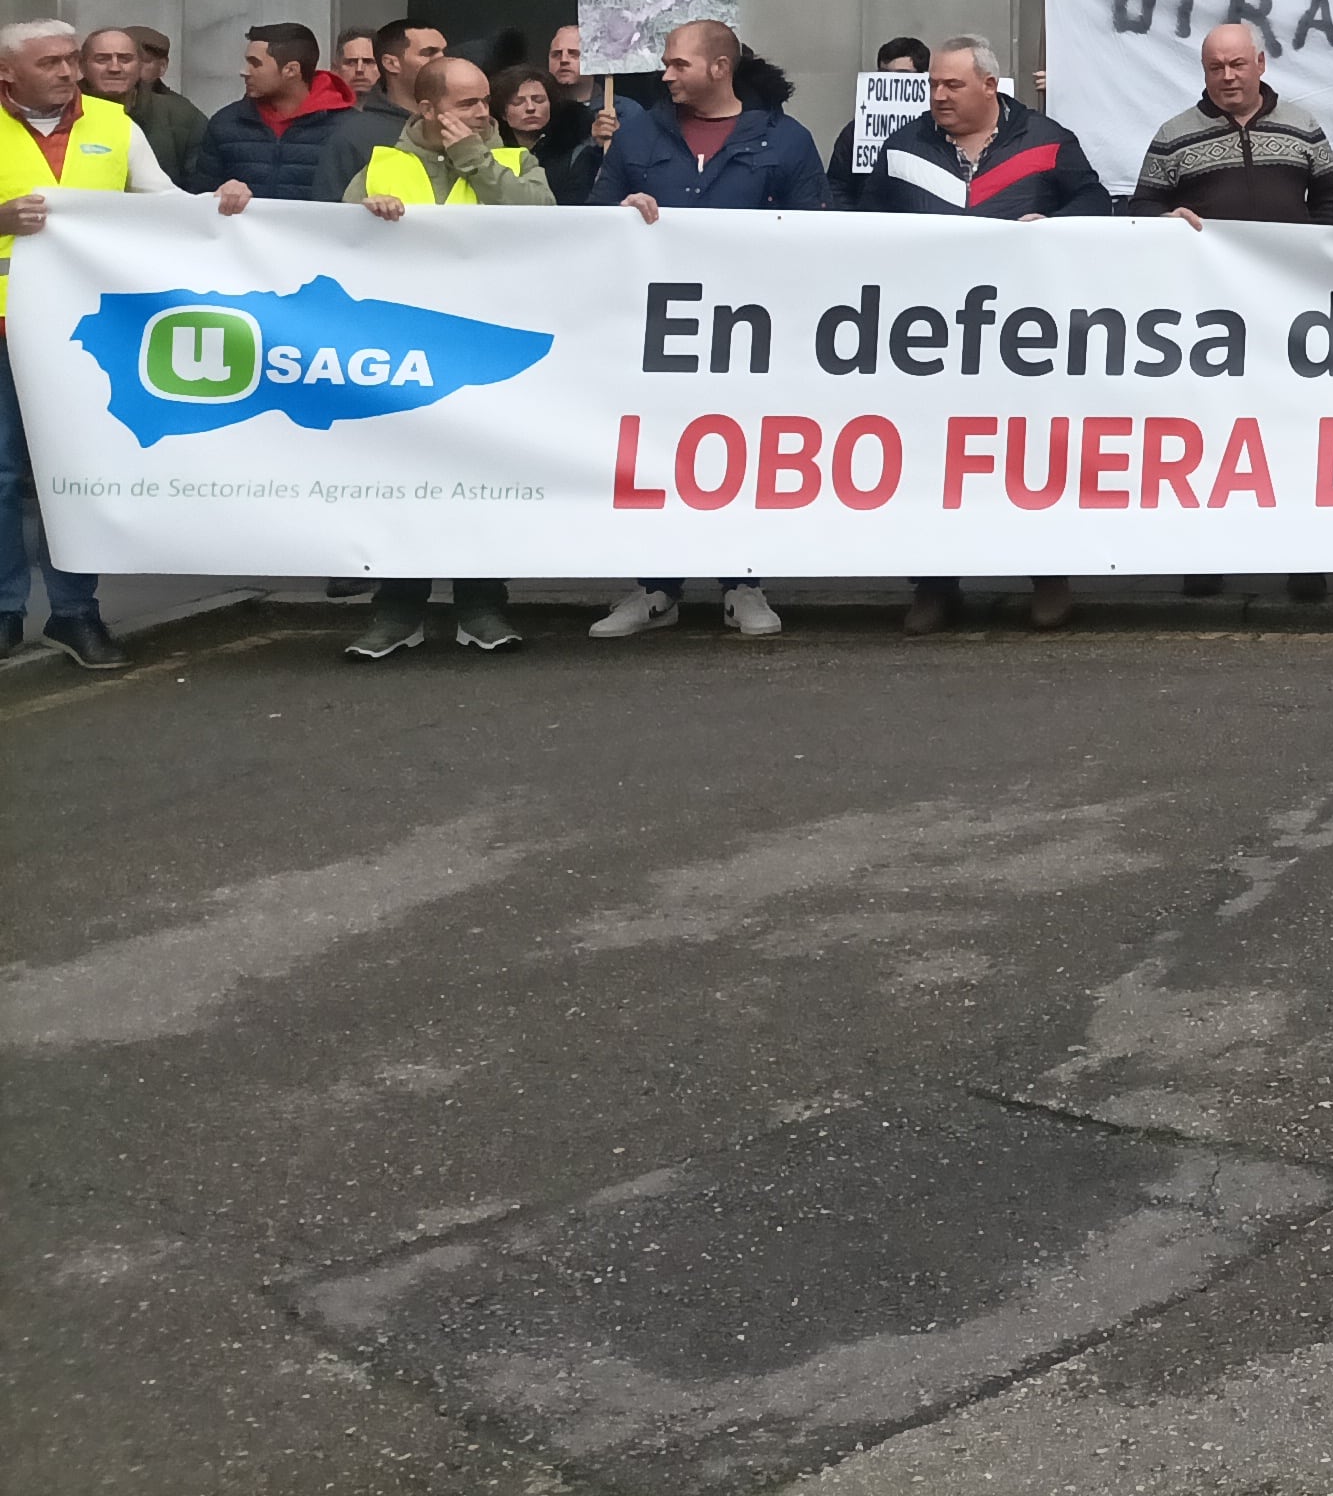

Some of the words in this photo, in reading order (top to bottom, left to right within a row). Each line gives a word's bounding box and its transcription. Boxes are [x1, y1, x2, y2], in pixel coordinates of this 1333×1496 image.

[868, 78, 926, 102] POLITICOS
[856, 144, 881, 167] ESC
[643, 283, 771, 373] En
[816, 284, 1246, 378] defensa
[613, 413, 903, 511] LOBO
[943, 416, 1277, 511] FUERA
[52, 477, 121, 497] Unión
[130, 478, 160, 498] de
[168, 478, 301, 499] Sectoriales
[307, 480, 406, 503] Agrarias
[414, 480, 443, 500] de
[451, 481, 545, 501] Asturias
